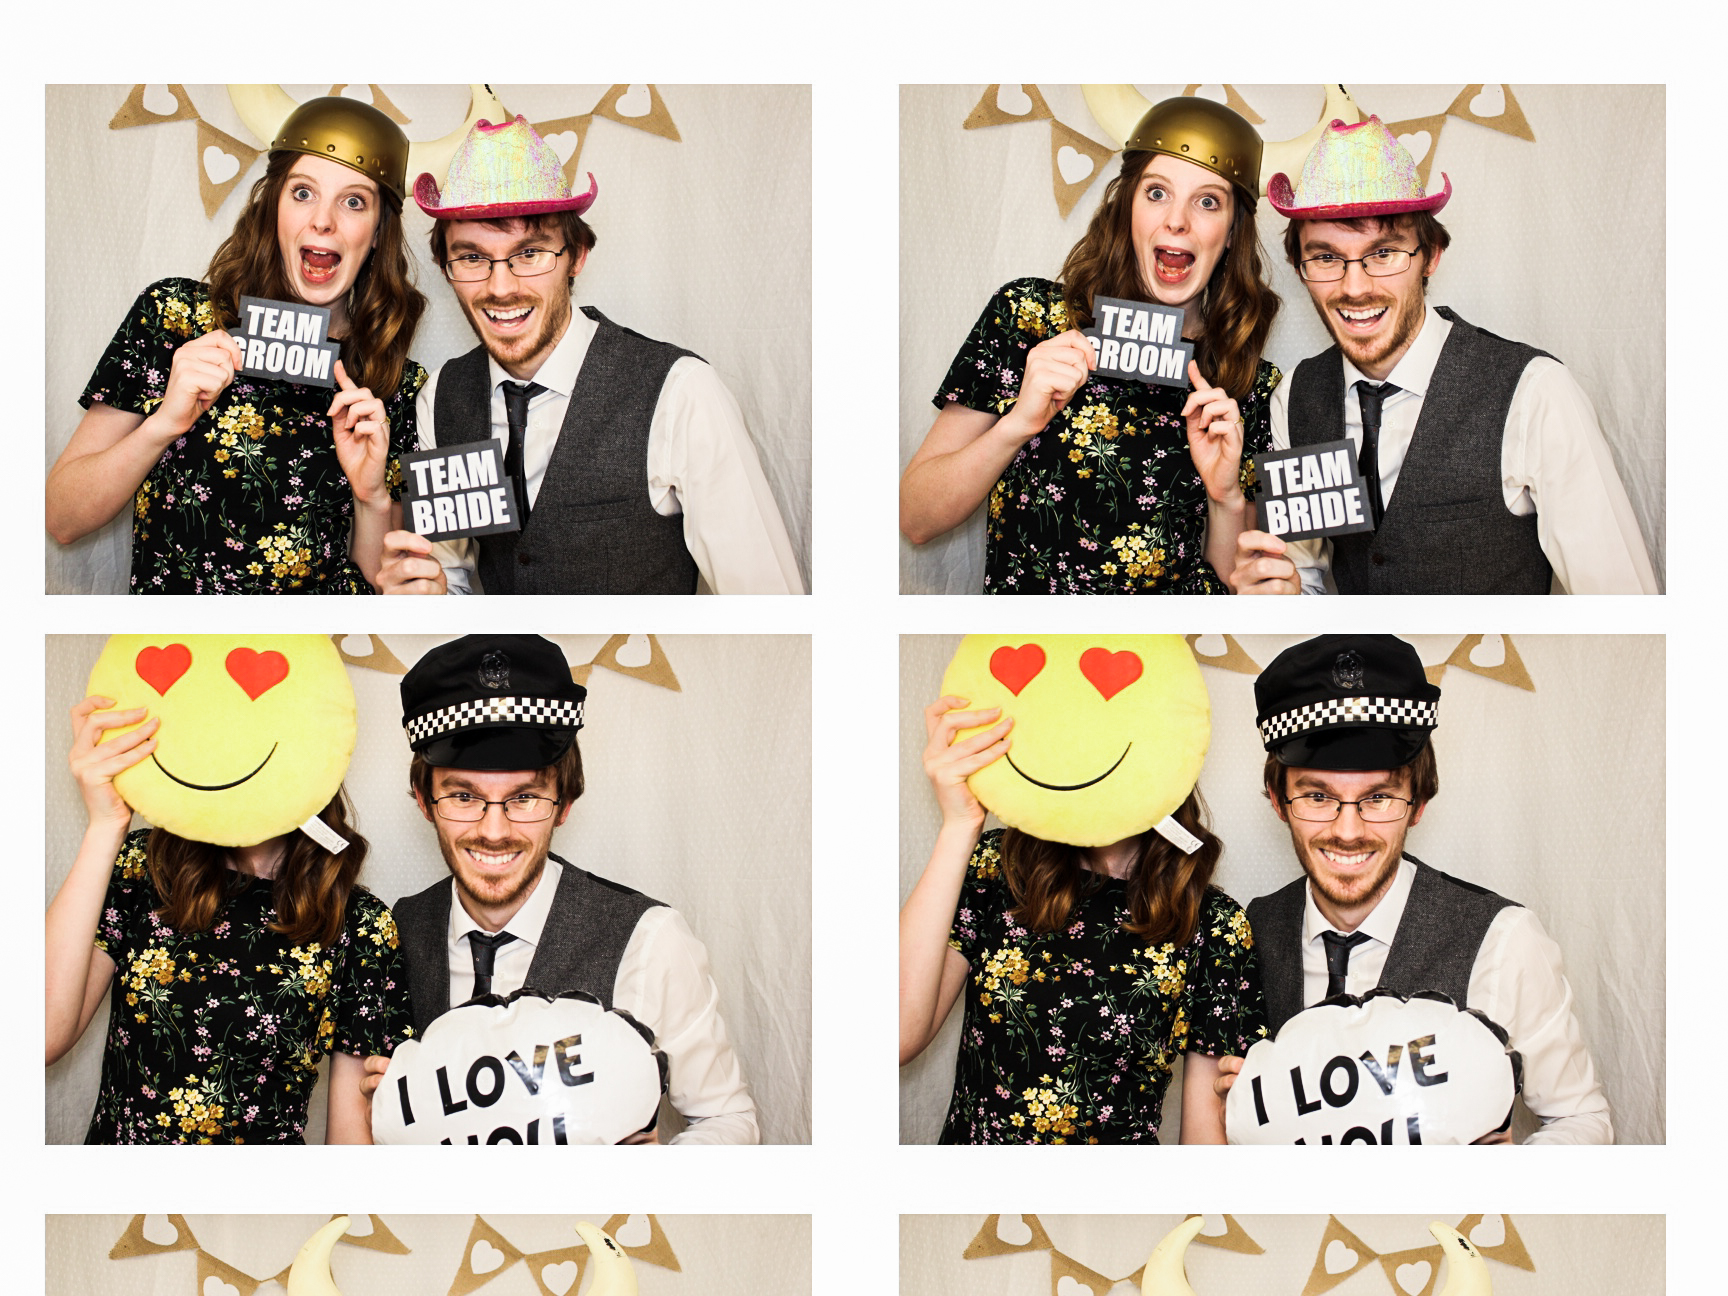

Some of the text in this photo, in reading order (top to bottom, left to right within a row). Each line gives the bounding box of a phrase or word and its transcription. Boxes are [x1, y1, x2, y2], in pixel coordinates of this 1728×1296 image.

[247, 304, 323, 346] TEAM
[1101, 304, 1177, 346] TEAM
[410, 449, 499, 496] TEAM
[1264, 449, 1353, 496] TEAM
[411, 487, 511, 536] BRIDE
[1265, 487, 1365, 536] BRIDE
[397, 1033, 595, 1127] I LOVE
[1251, 1033, 1449, 1127] I LOVE
